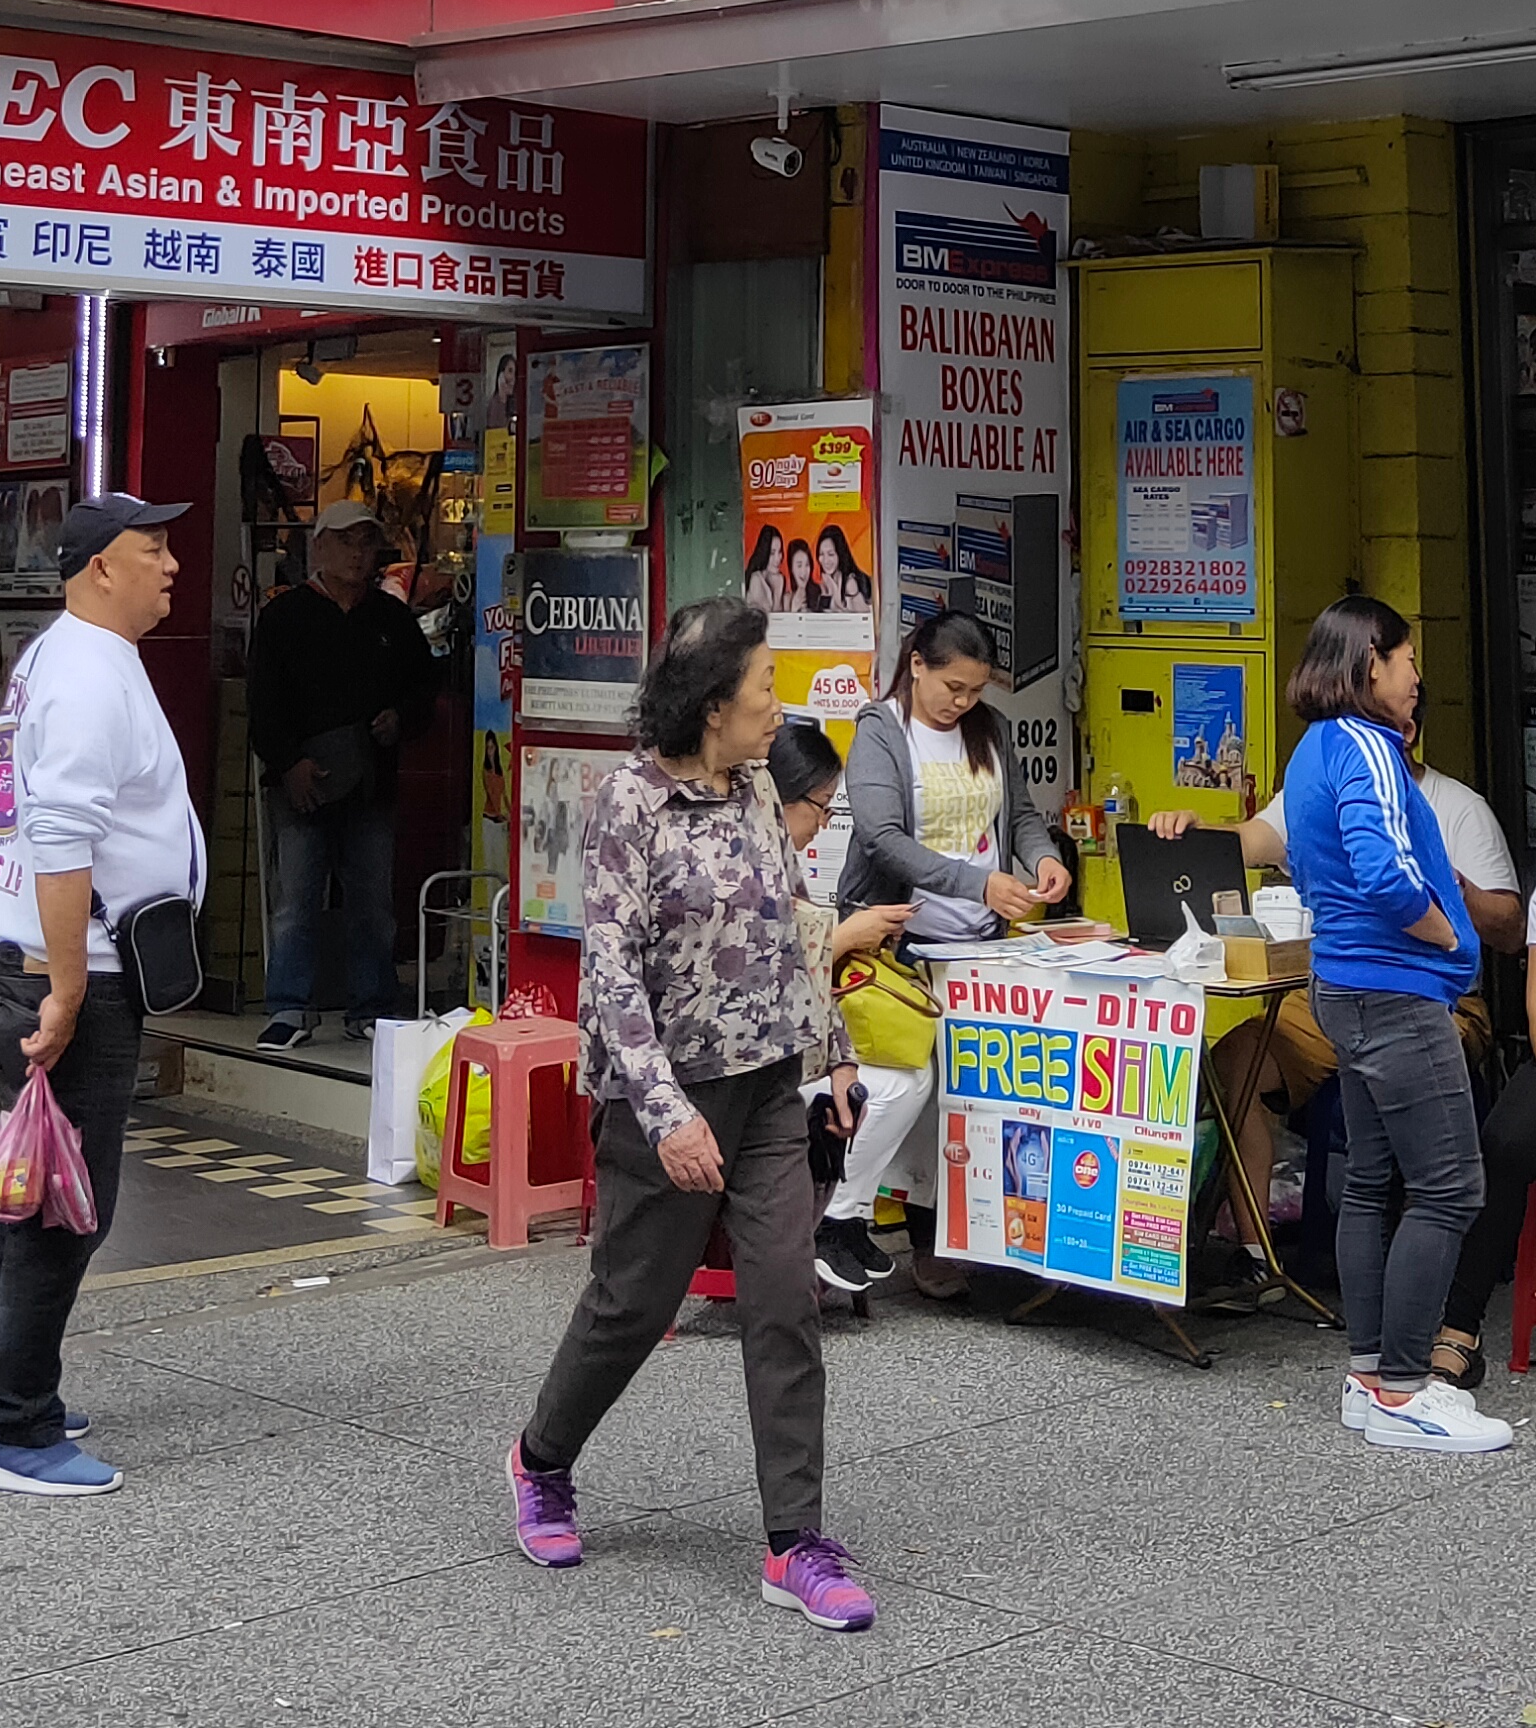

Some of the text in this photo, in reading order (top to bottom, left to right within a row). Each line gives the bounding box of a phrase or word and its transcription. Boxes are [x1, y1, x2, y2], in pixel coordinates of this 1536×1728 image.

[160, 69, 565, 197] 東南亞食品
[900, 138, 1050, 171] AUSTRALIA KOREA
[96, 164, 204, 206] Asian
[216, 176, 244, 210] &
[251, 177, 411, 228] Imported
[419, 194, 566, 238] Products
[31, 217, 114, 268] 印尼
[143, 226, 223, 278] 越南
[251, 238, 327, 285] 泰國
[352, 243, 567, 303] 進口食品百貨
[896, 277, 970, 295] DOOR DOOR
[899, 304, 1055, 364] BALIKBAYAN
[940, 364, 1023, 417] BOXES
[899, 418, 1058, 473] AVAILABLE AT
[1123, 417, 1245, 443] AIR SEA CARGO
[750, 460, 775, 489] 90
[1124, 446, 1244, 478] AVAILABLE HERE
[1124, 559, 1247, 577] 0928321802
[1124, 576, 1247, 596] 0229264409
[813, 677, 858, 695] 45 GB
[950, 1024, 1072, 1104] FREE
